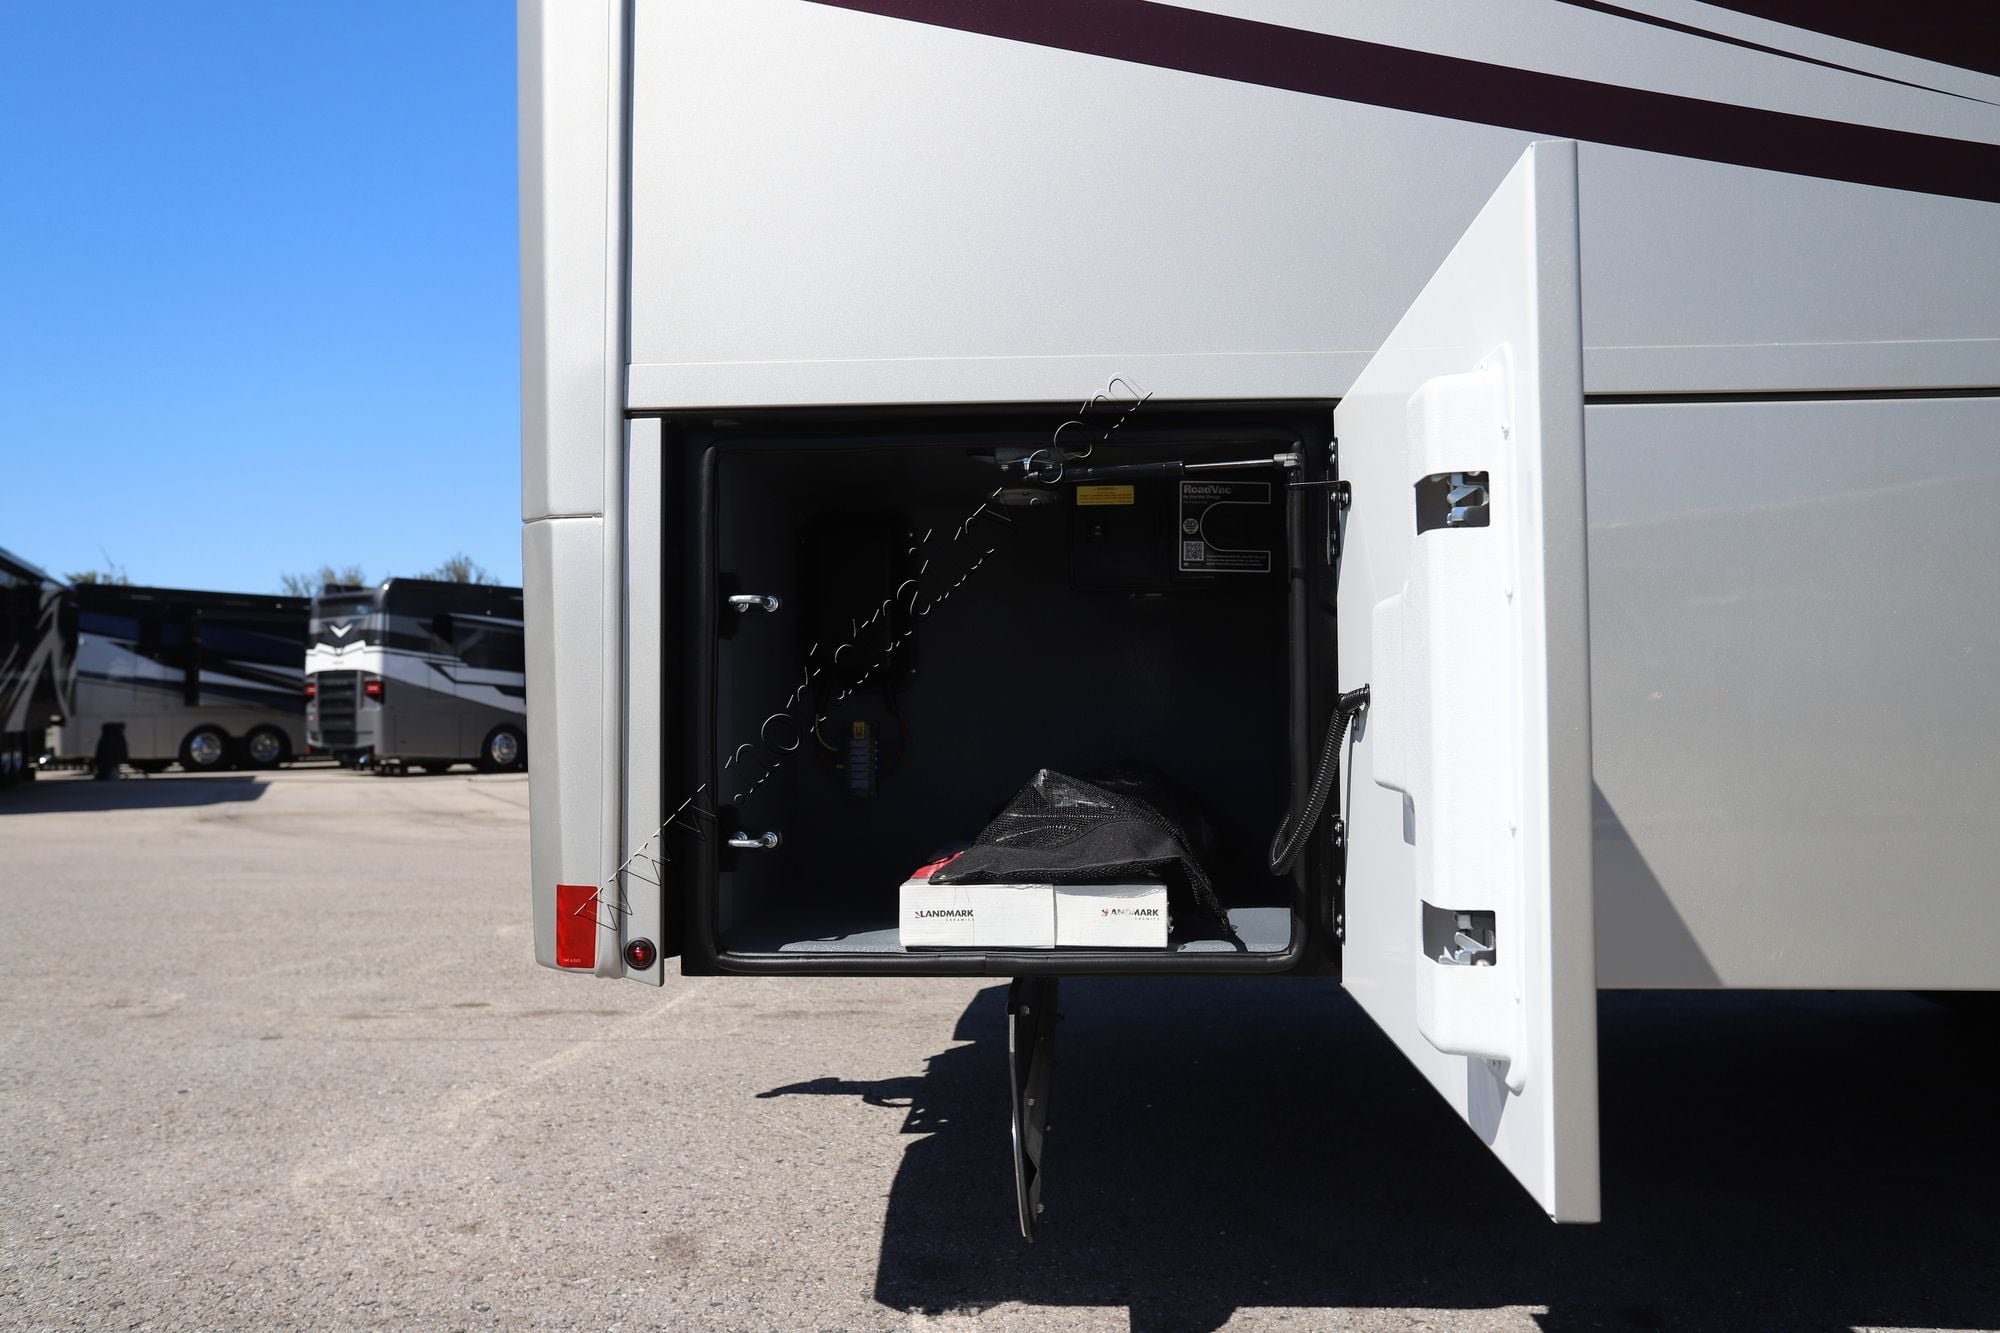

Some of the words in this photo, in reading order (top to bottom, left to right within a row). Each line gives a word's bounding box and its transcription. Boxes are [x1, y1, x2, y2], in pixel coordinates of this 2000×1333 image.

[1183, 484, 1232, 494] RoadVac
[920, 909, 974, 918] LANDMARK
[1107, 908, 1159, 917] ANMARK
